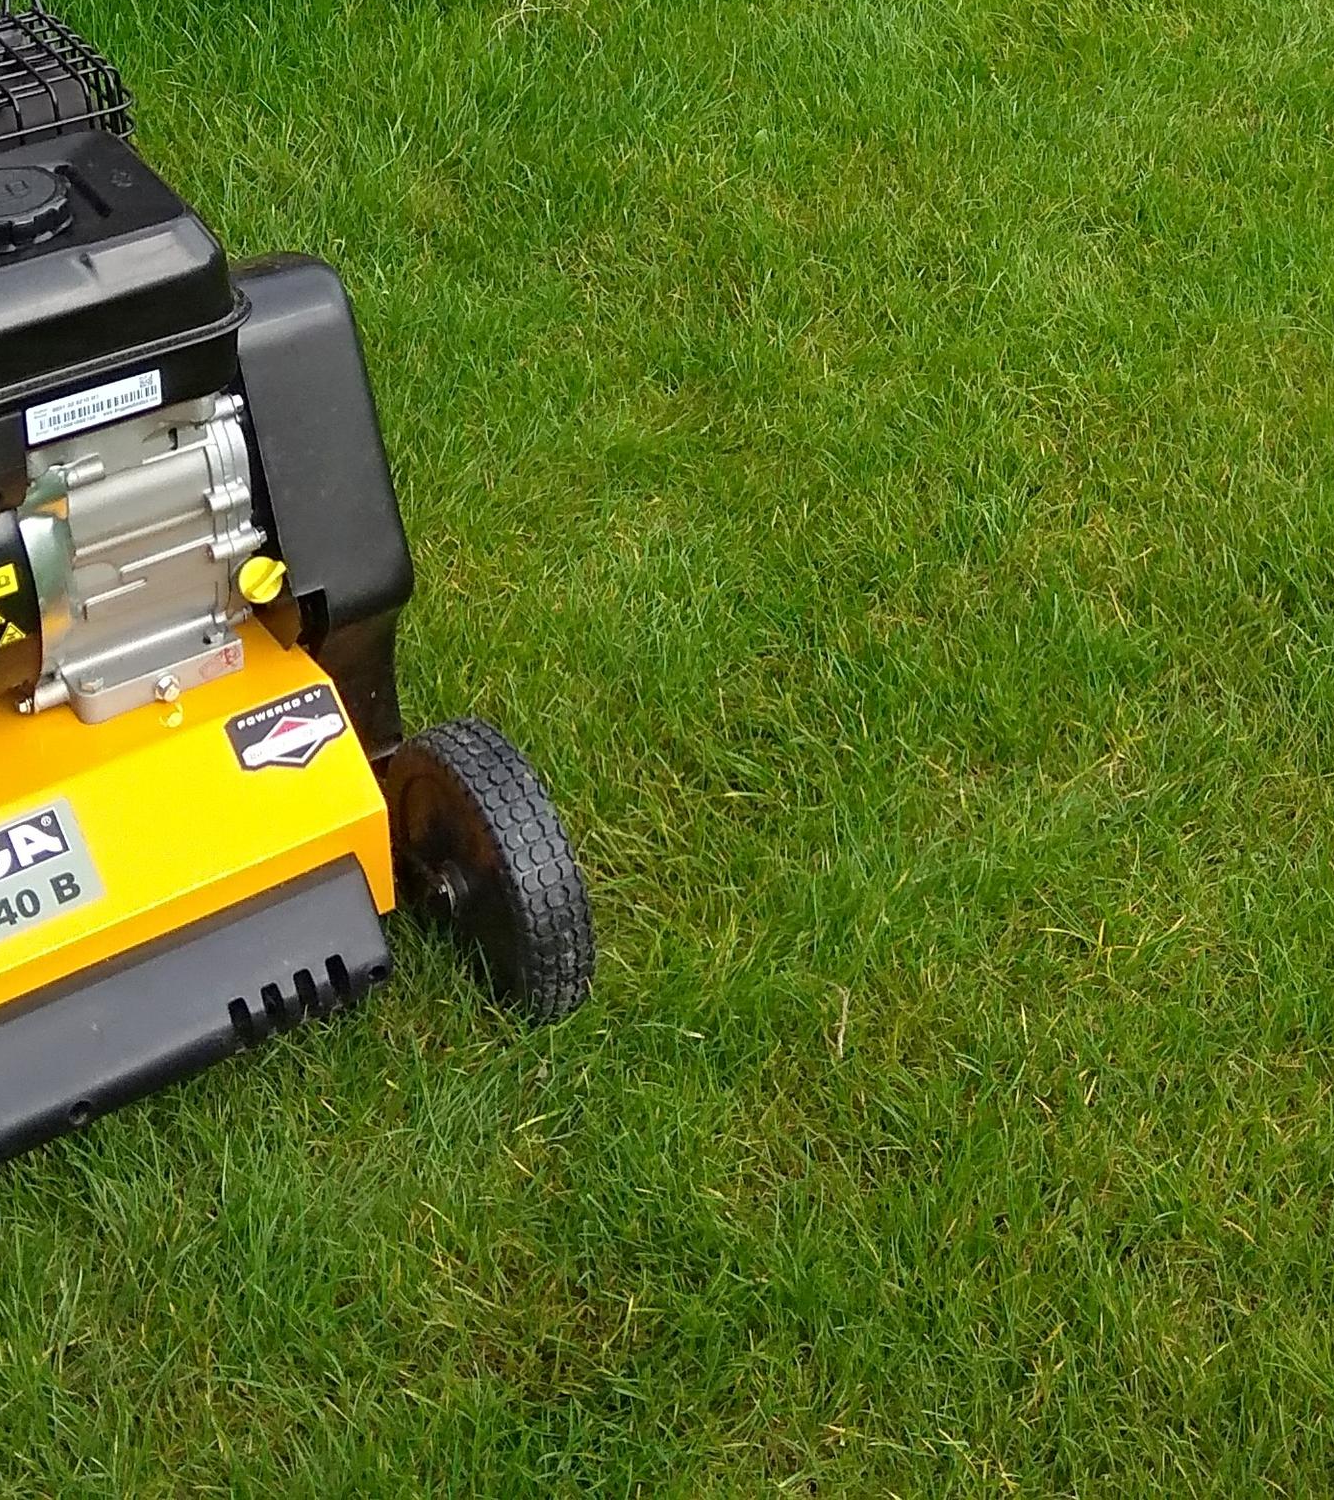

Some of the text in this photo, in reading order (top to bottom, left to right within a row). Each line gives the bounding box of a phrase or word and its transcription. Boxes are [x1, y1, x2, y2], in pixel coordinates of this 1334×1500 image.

[236, 688, 322, 730] POWERED BY
[49, 871, 81, 905] B
